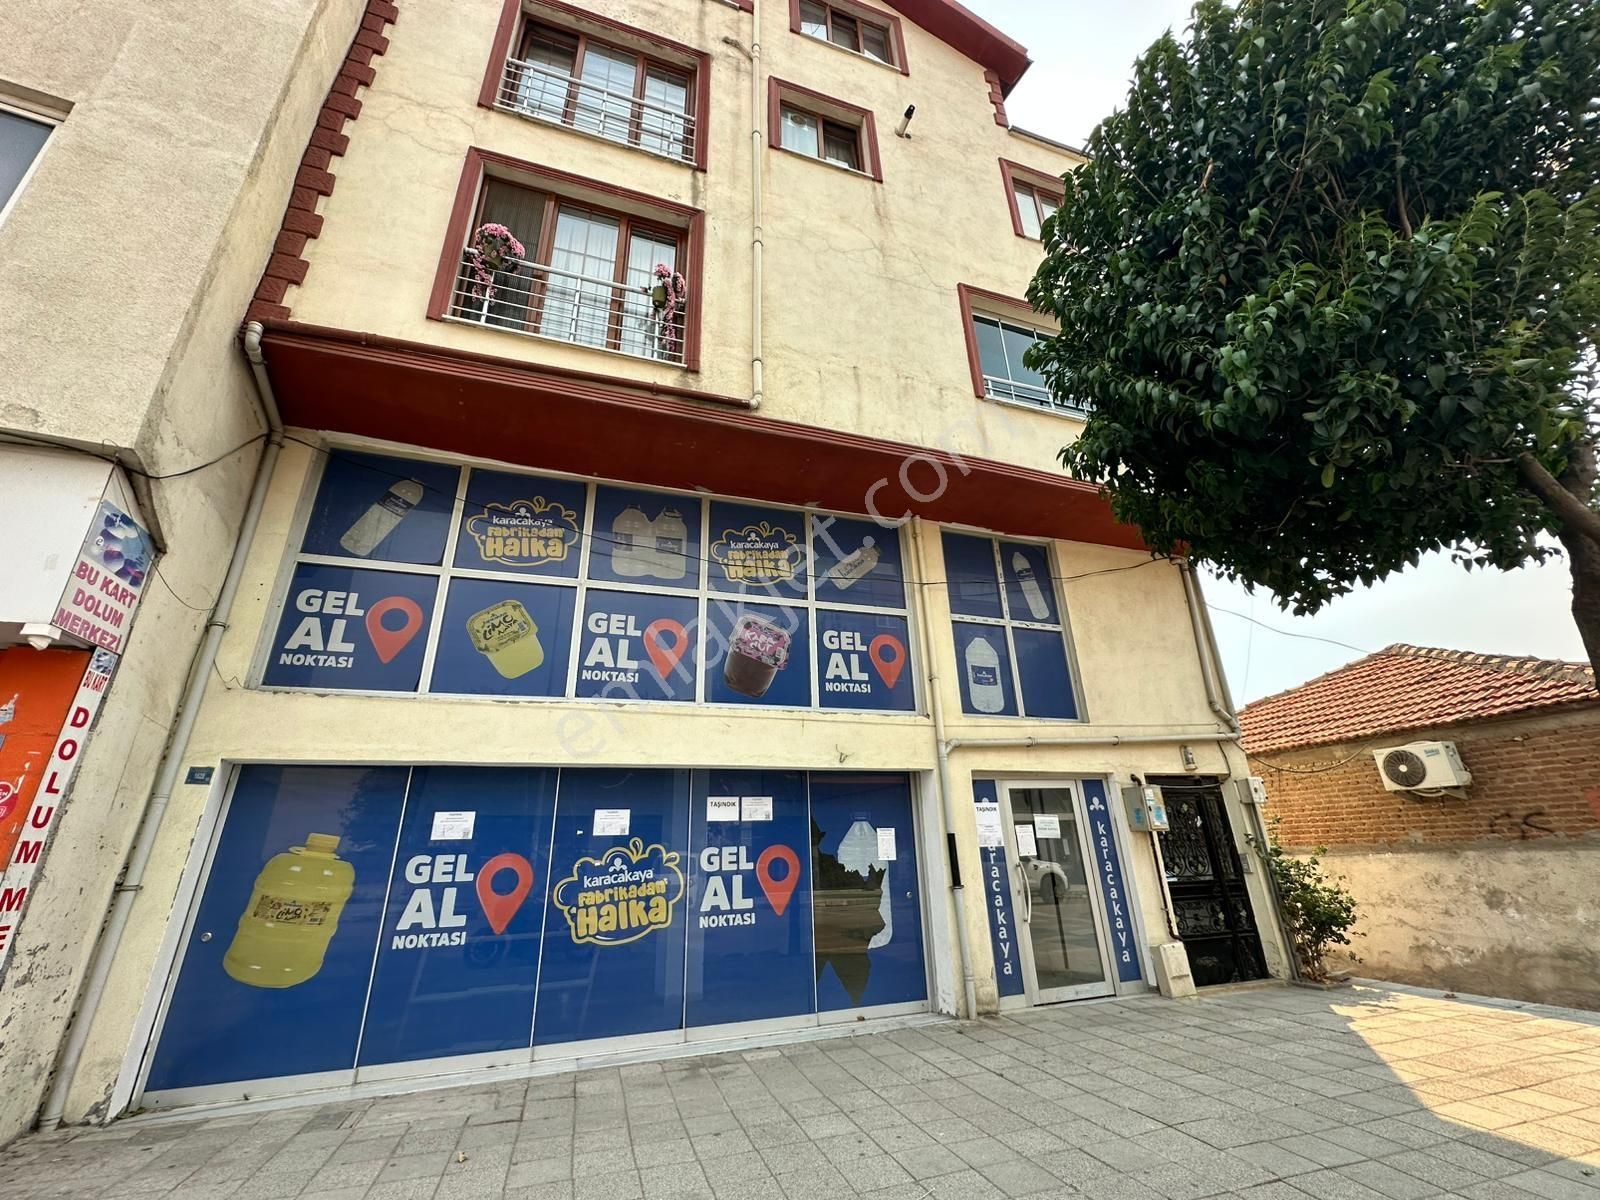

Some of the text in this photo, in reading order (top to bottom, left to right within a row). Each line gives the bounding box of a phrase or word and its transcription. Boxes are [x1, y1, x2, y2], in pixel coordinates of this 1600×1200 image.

[486, 537, 563, 557] Halka
[730, 540, 779, 550] karacakaya
[75, 560, 137, 609] BU KART
[72, 587, 124, 627] DOLUM
[296, 588, 364, 617] GEL
[55, 607, 122, 653] MERKEZİ
[284, 617, 355, 652] AL
[587, 612, 642, 637] GEL
[584, 638, 639, 670] AL
[823, 630, 868, 651] GEL
[279, 652, 353, 668] NOKTASI
[825, 652, 869, 681] AL
[82, 670, 109, 692] BU KART
[582, 669, 639, 683] NOKTASI
[825, 682, 871, 693] NOKTASI
[15, 706, 90, 864] DOLUM
[710, 801, 736, 809] TAŞINDIK
[405, 853, 474, 884] GEL
[700, 845, 754, 872] GEL
[583, 869, 654, 888] karacakaya
[1096, 820, 1131, 963] karacakaya
[700, 875, 753, 912] AL
[396, 887, 467, 931] AL
[576, 895, 667, 937] Halka
[699, 913, 755, 929] NOKTASI
[987, 846, 1014, 975] racakaya
[392, 931, 466, 950] NOKTASI
